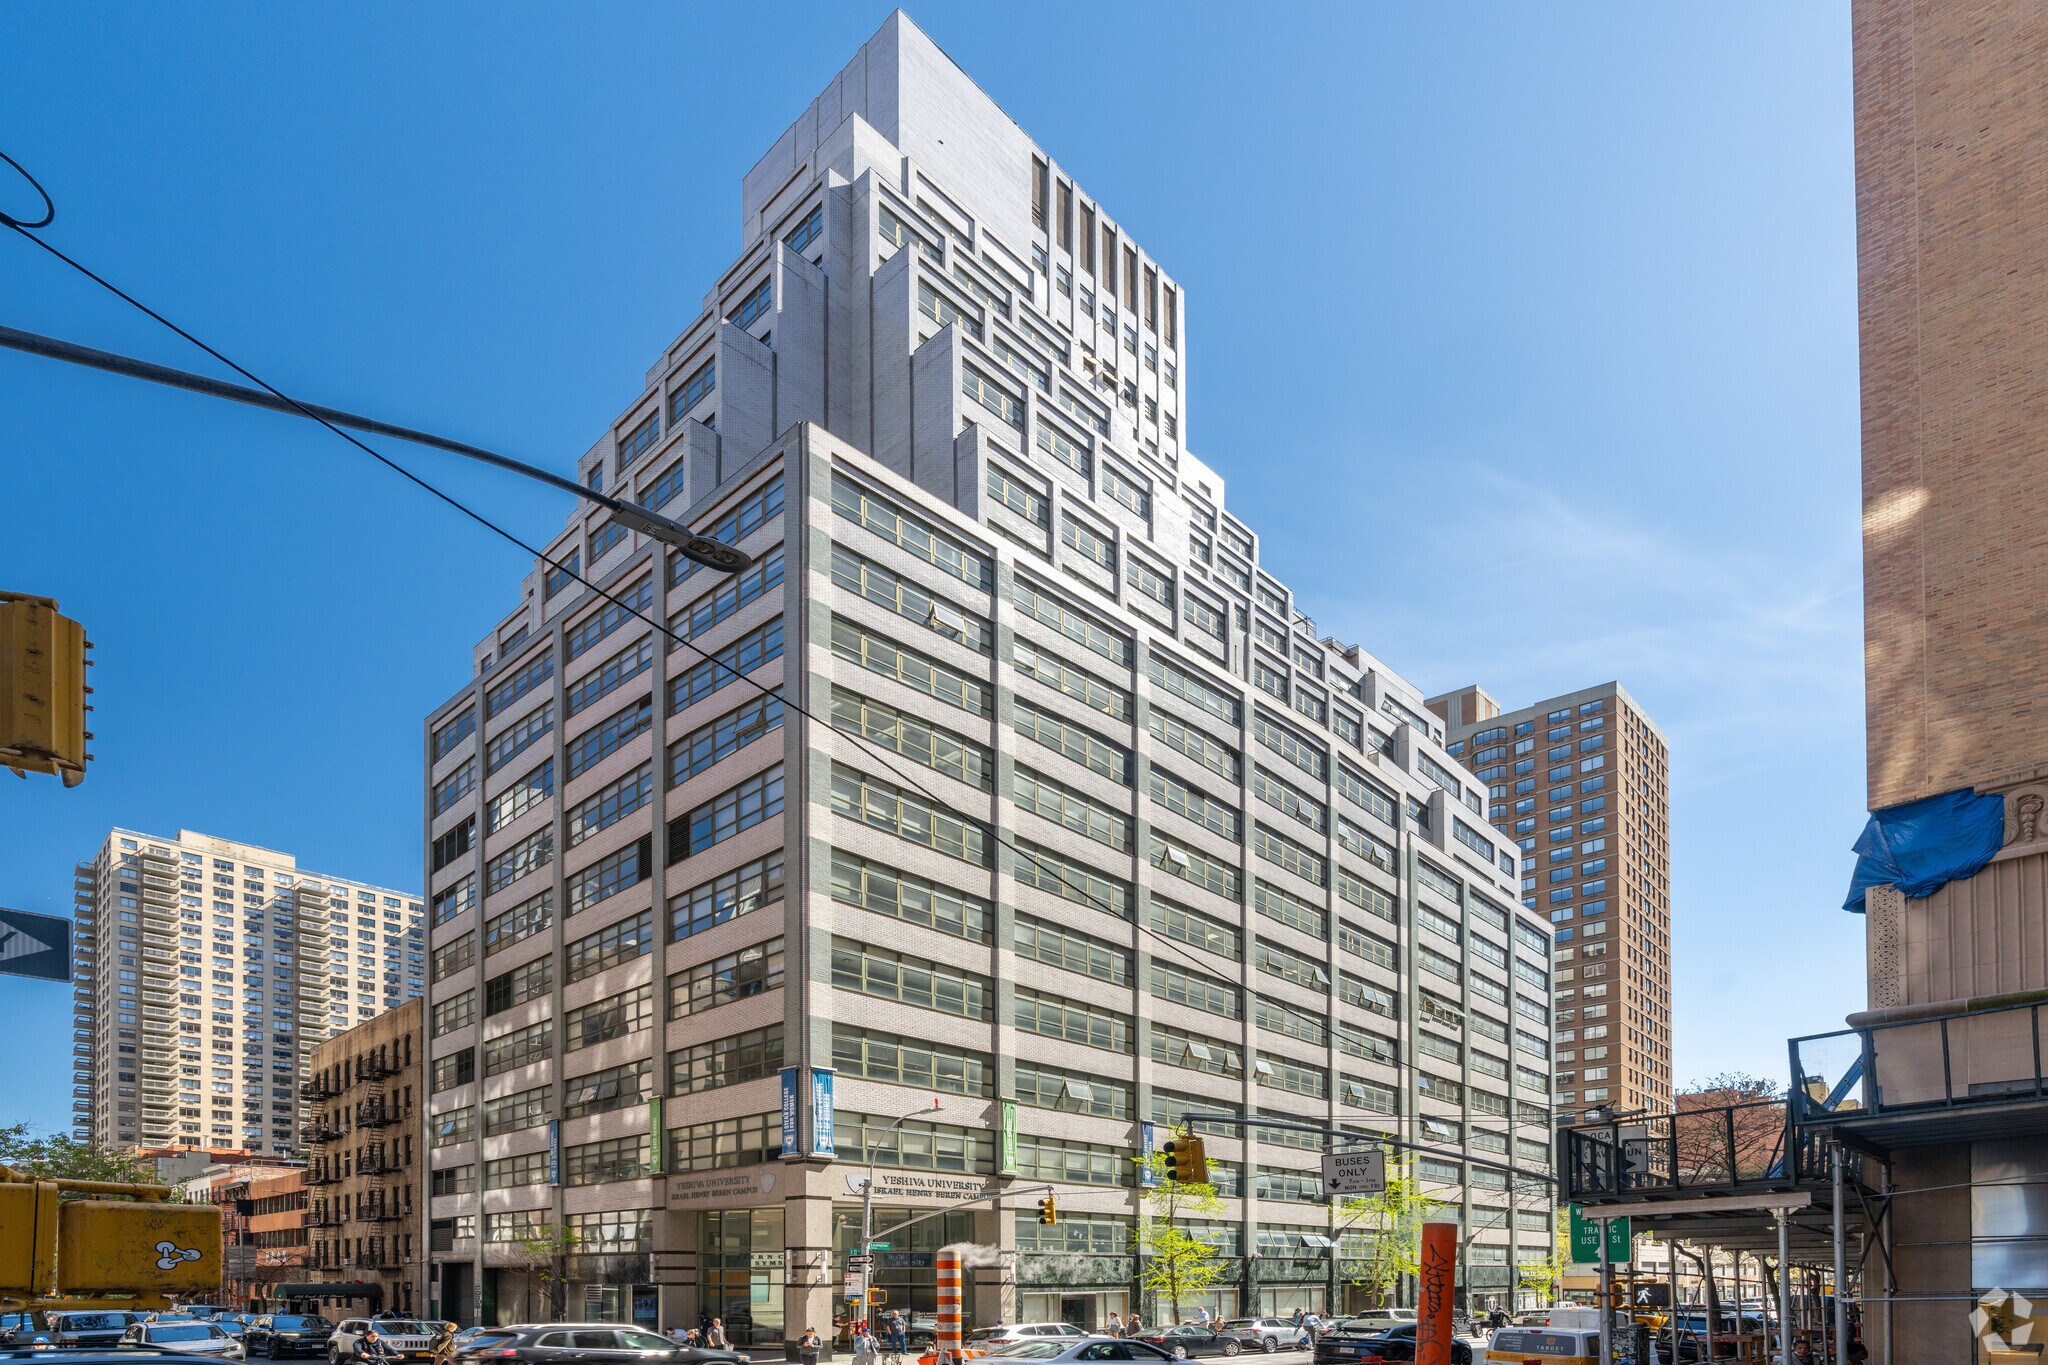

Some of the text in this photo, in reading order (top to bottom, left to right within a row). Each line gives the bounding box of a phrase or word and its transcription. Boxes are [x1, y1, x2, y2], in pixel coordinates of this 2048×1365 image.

[1335, 1156, 1370, 1167] BUSES
[1338, 1168, 1367, 1177] ONLY
[676, 1176, 751, 1190] YESHIVA UNIVERSITY
[882, 1175, 985, 1191] YESHIVA UNIVERSITY
[671, 1186, 758, 1200] ISRAEL HENRY BEREN CAMPUS
[873, 1187, 992, 1201] ISRAEL HENRY BEREN CAMP
[1583, 1226, 1617, 1235] TRAIC
[1581, 1235, 1621, 1245] USE St
